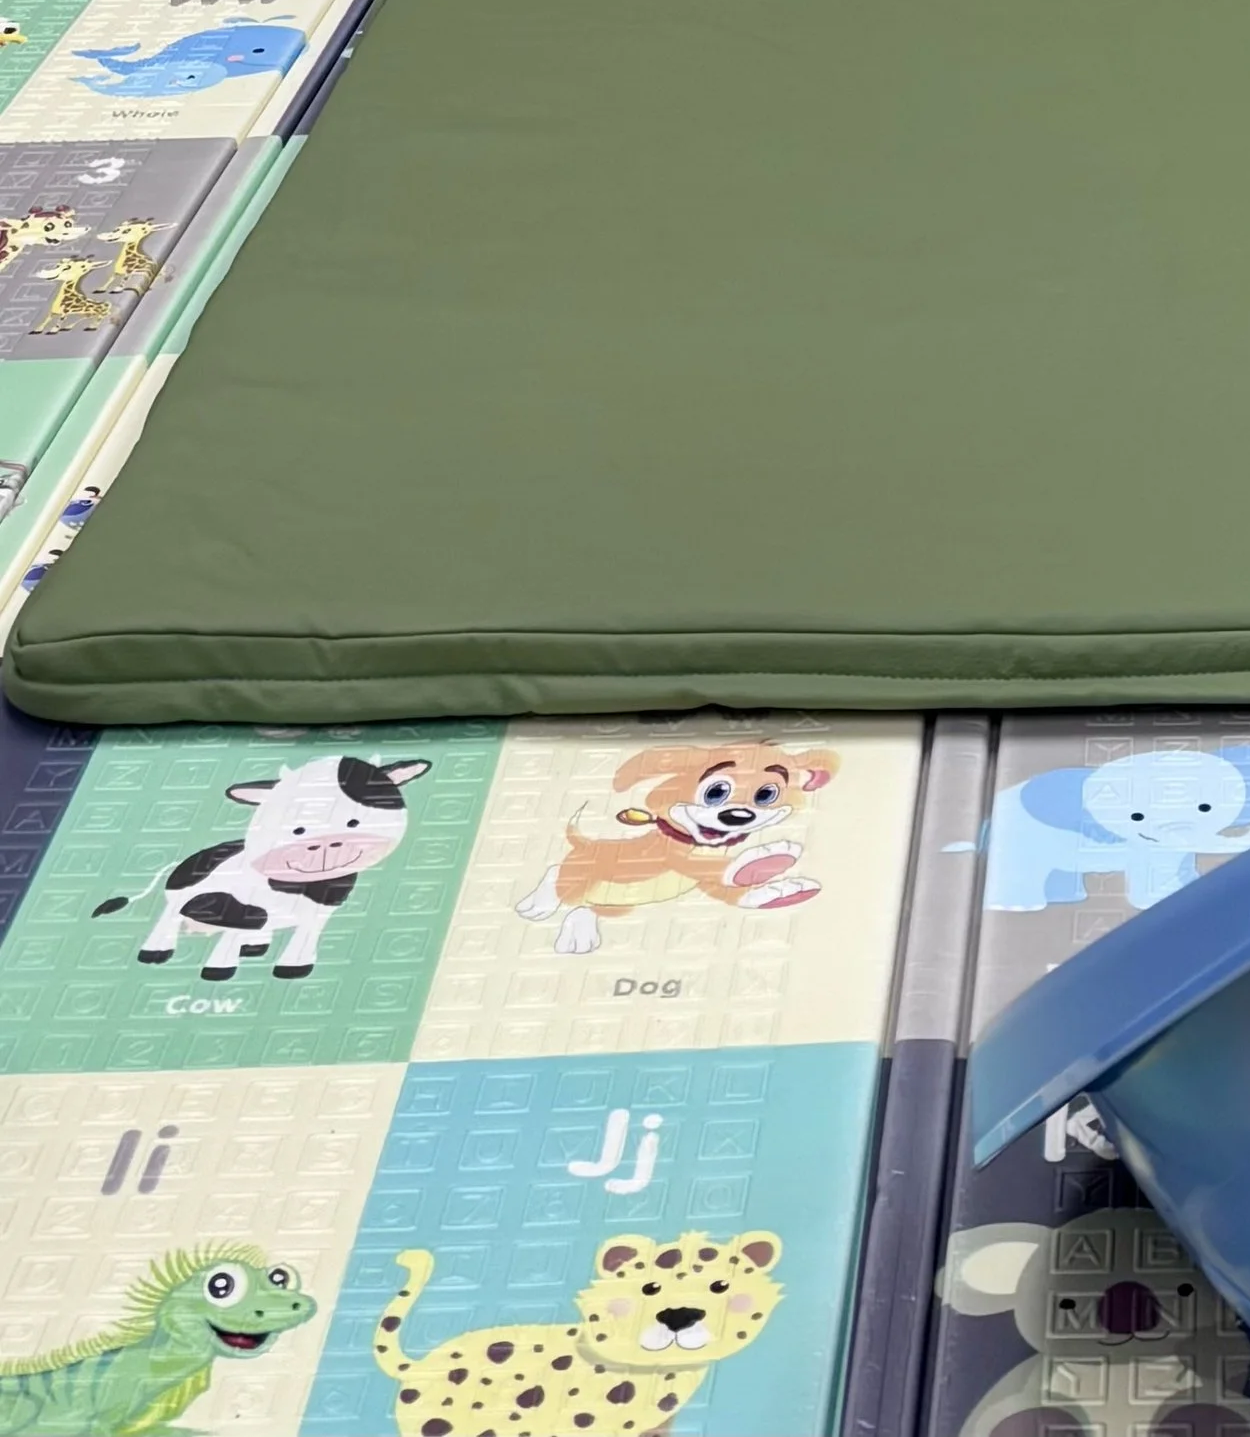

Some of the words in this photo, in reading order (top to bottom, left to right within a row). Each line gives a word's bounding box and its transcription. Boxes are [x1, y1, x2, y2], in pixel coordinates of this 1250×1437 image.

[78, 155, 126, 185] 3
[611, 977, 684, 999] Dog
[165, 994, 244, 1016] Cow
[100, 1125, 181, 1197] Ii
[567, 1108, 664, 1195] Jj
